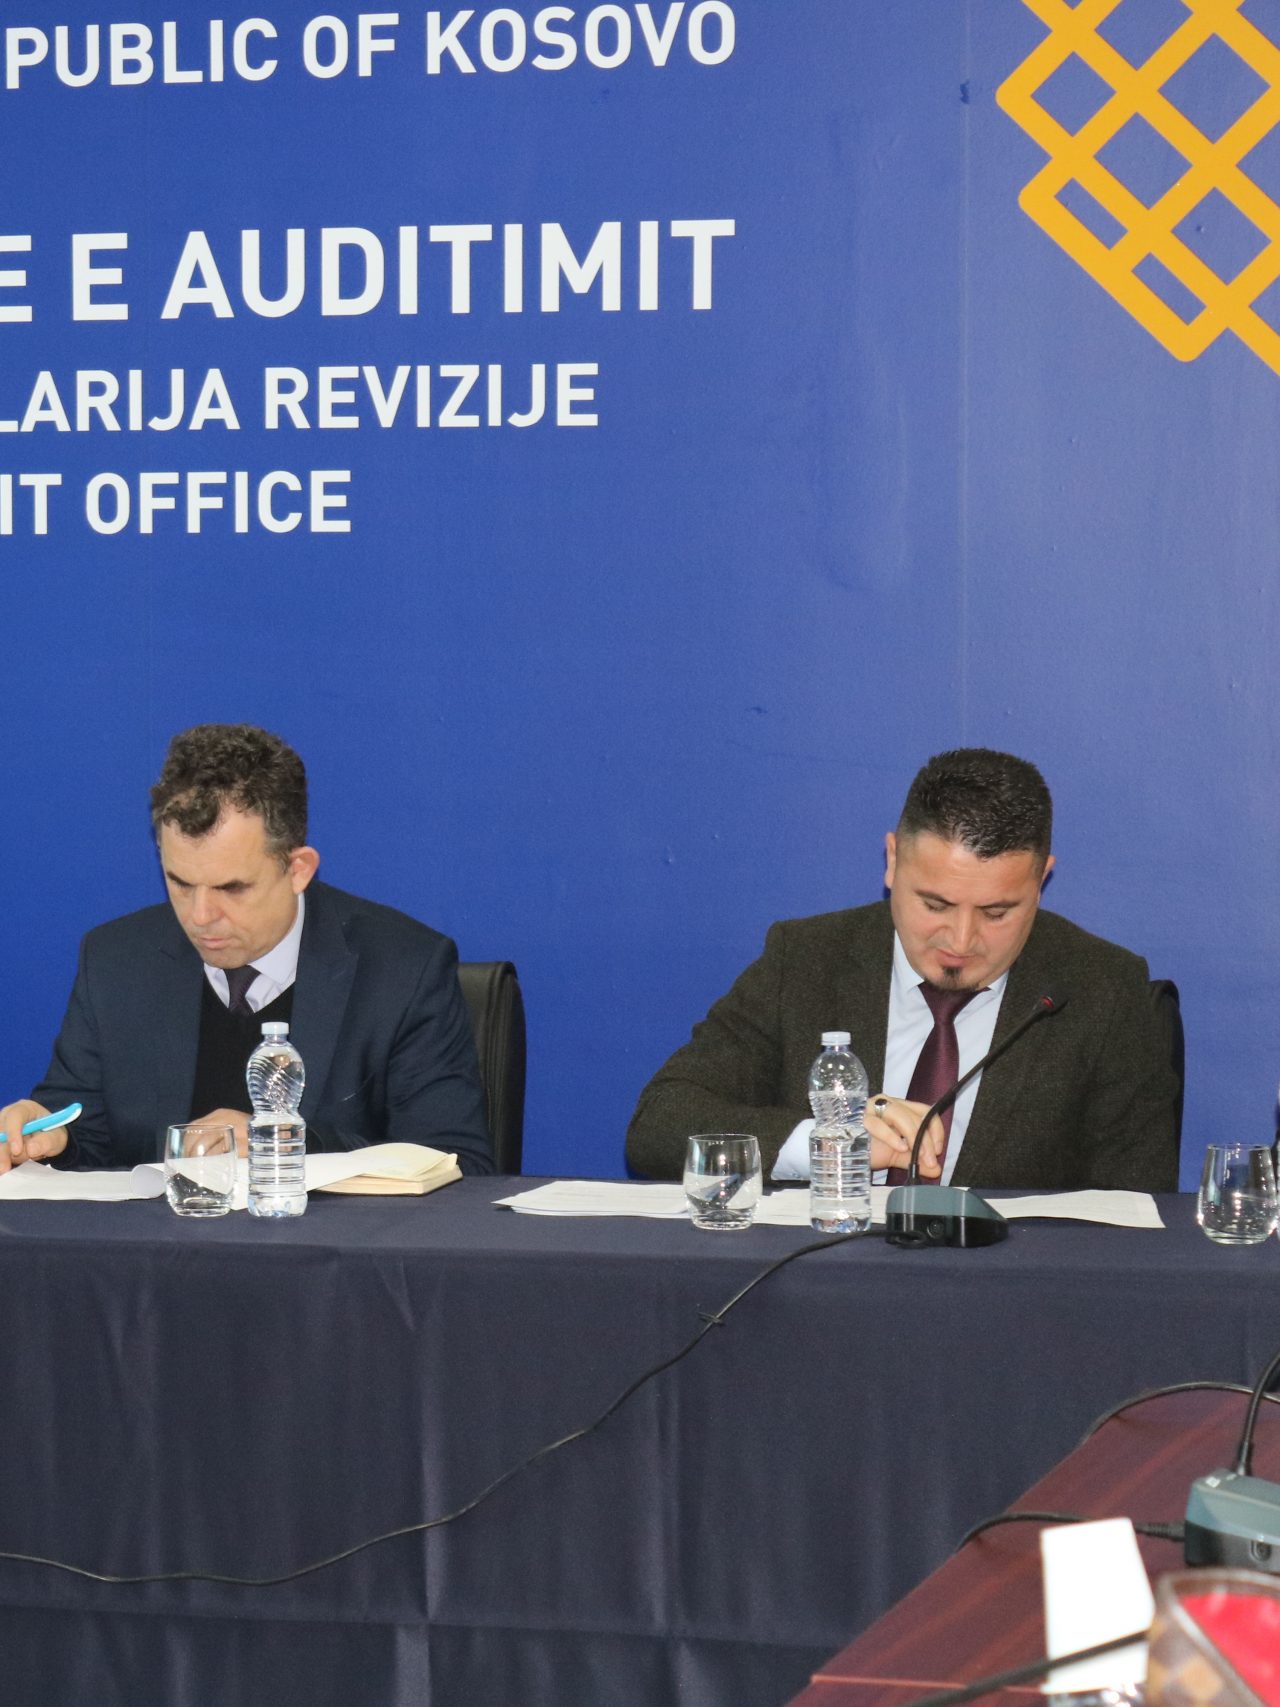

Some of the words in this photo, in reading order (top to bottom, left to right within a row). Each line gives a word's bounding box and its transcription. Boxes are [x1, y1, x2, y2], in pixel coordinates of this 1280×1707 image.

[302, 13, 399, 79] OF
[426, 0, 735, 75] KOSOVO
[71, 232, 128, 322] E
[160, 217, 736, 320] AUDITIMIT
[264, 362, 599, 430] REVIZIJE
[85, 470, 351, 535] OFFICE
